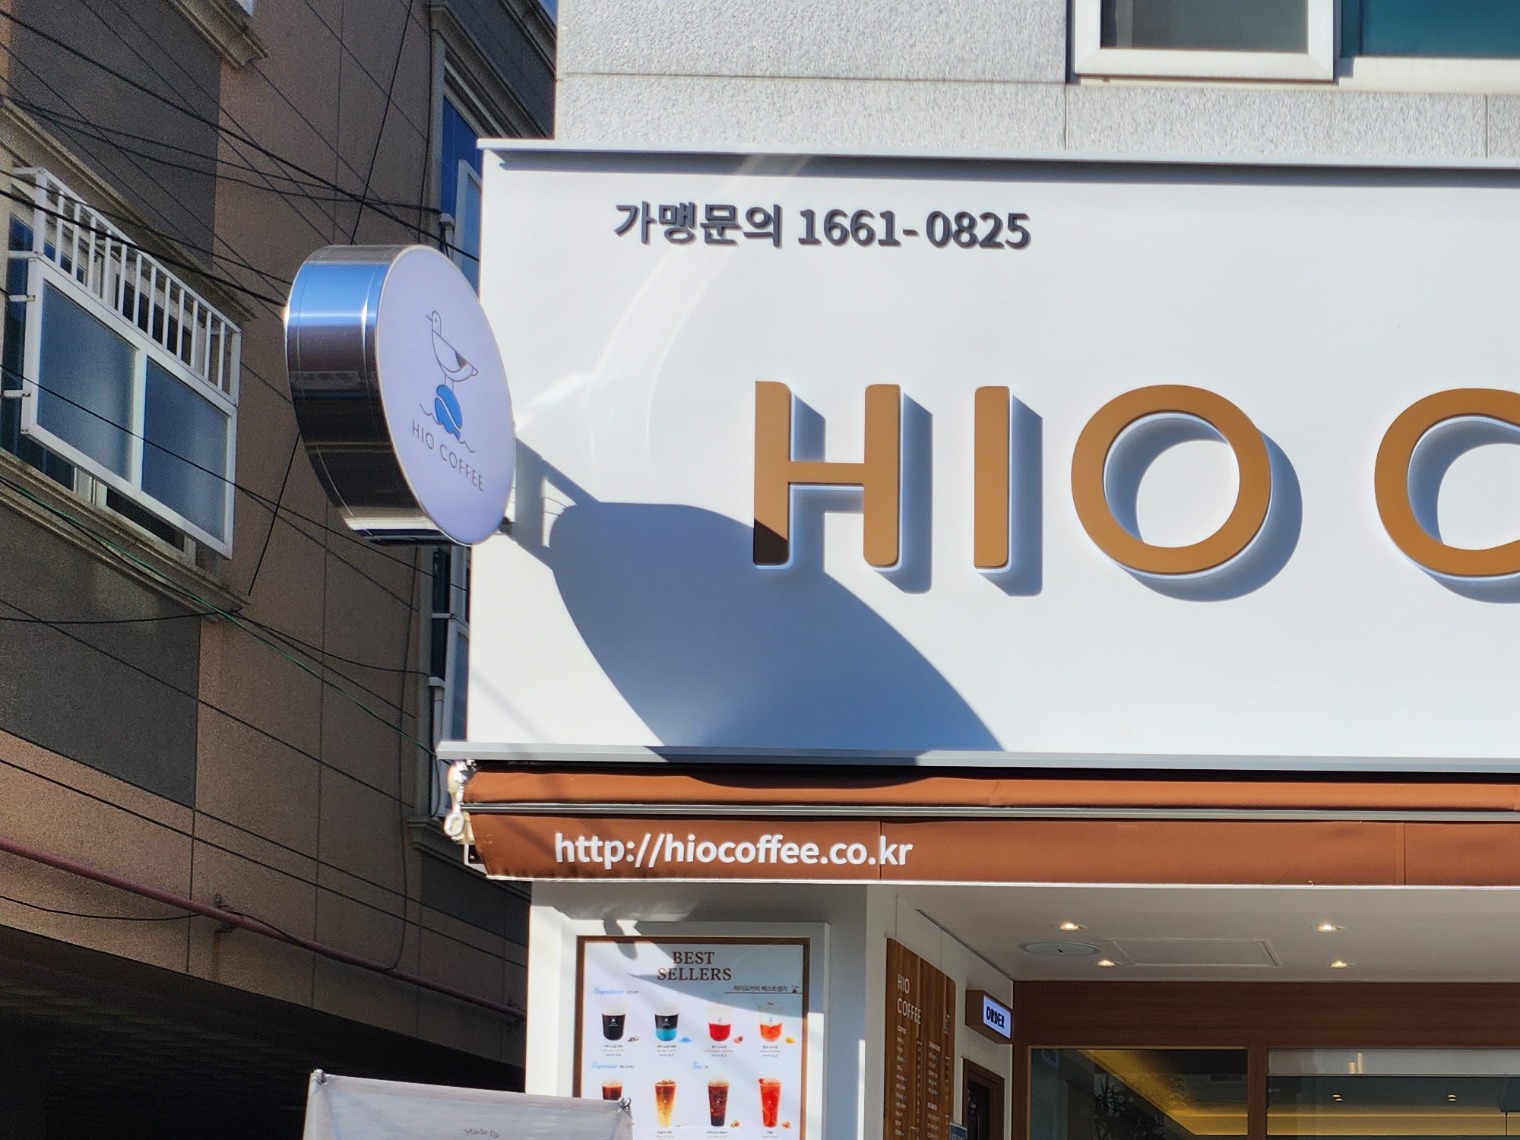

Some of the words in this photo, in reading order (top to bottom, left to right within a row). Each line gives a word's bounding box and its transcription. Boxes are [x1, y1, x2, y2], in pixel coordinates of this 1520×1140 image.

[613, 201, 783, 248] 가맹문의
[797, 208, 1031, 250] 1661-0825
[412, 420, 435, 450] HIO
[439, 443, 485, 492] COFFEE
[753, 380, 1272, 576] HIO
[555, 832, 913, 870] http://hiocoffee.co.kr
[672, 951, 715, 965] BEST
[656, 967, 732, 981] SELLERS
[897, 973, 910, 994] HIO
[897, 997, 922, 1025] COFFEE
[985, 1005, 1005, 1029] ORDER
